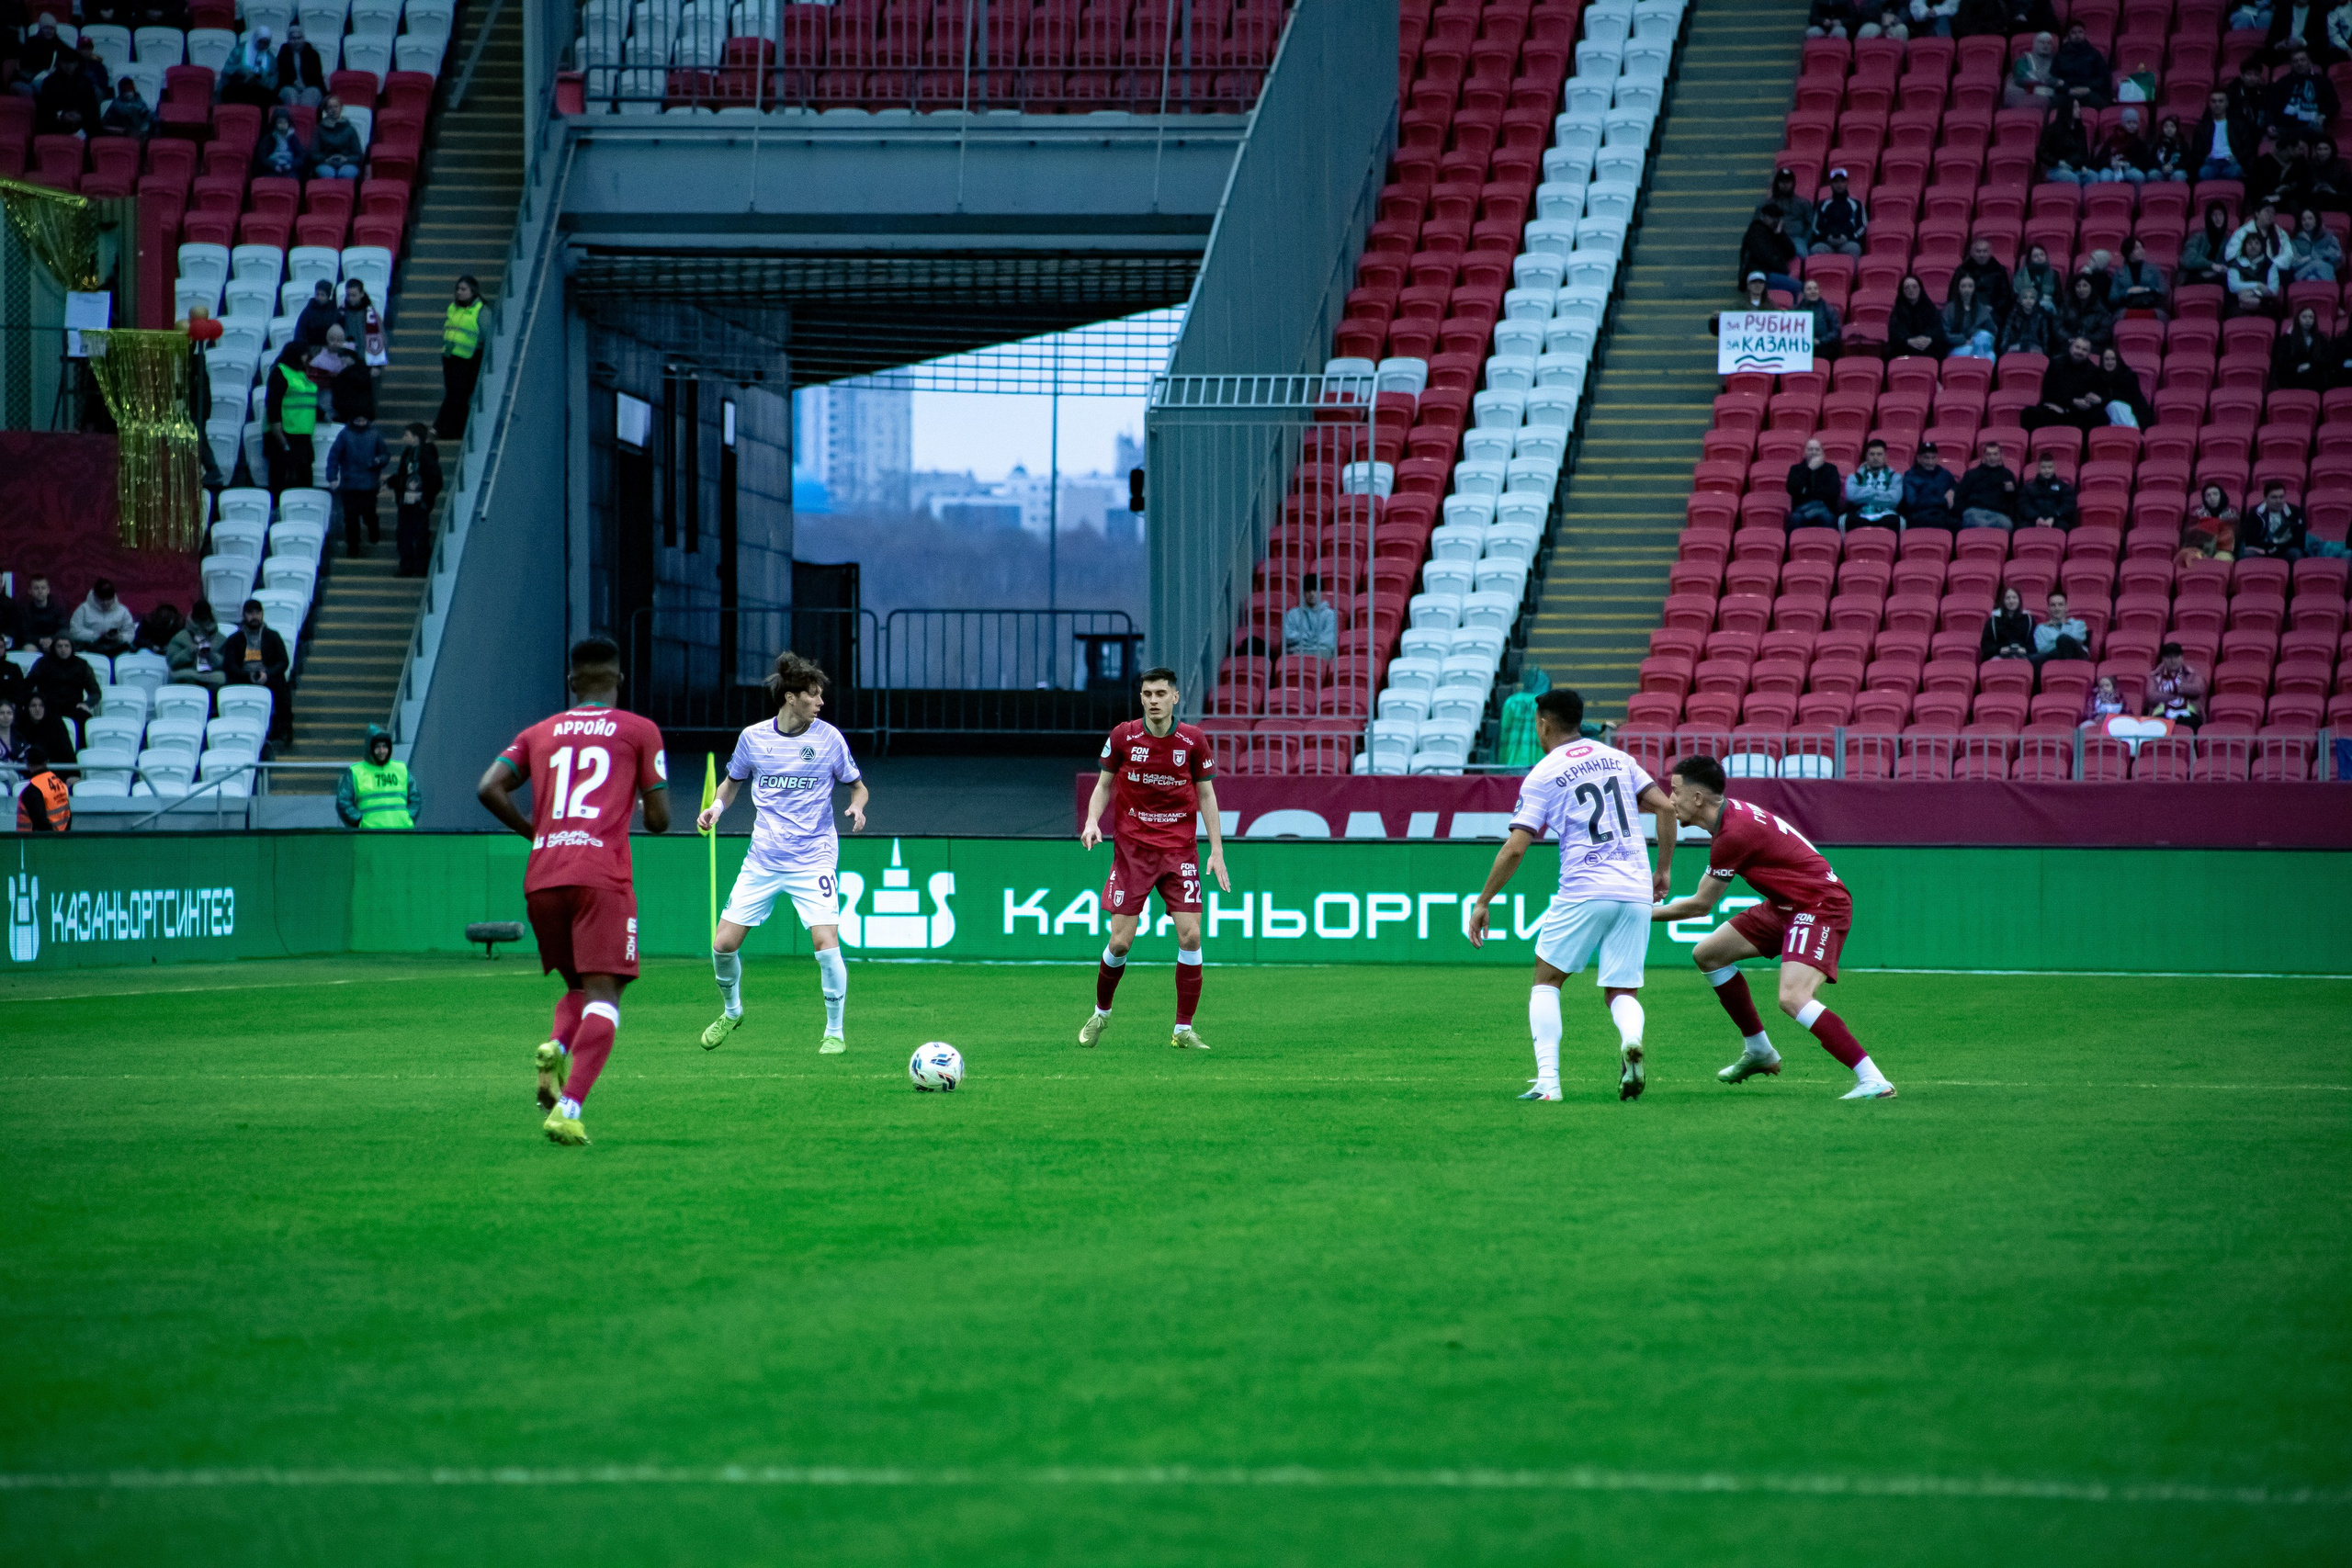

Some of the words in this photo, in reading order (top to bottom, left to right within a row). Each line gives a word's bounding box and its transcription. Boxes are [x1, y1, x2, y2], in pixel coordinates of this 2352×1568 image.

[1745, 314, 1805, 333] РУБИН
[1742, 335, 1811, 353] КАЗАНЬ
[553, 717, 617, 737] АРРОЙО
[1131, 746, 1149, 755] FON
[1131, 754, 1149, 762] BET
[374, 773, 399, 788] 7940
[549, 746, 611, 819] 12
[759, 774, 819, 790] FONBET
[1555, 757, 1623, 788] ФЕРНАНДЕС
[1575, 775, 1632, 845] 21
[1713, 869, 1735, 877] КОС
[819, 874, 838, 898] 91
[1182, 880, 1203, 904] 22
[51, 886, 234, 943] КАЗАНЬОРГСИНТЕЗ
[1794, 912, 1815, 923] FON
[1788, 926, 1810, 954] 11
[1819, 926, 1830, 946] КОС
